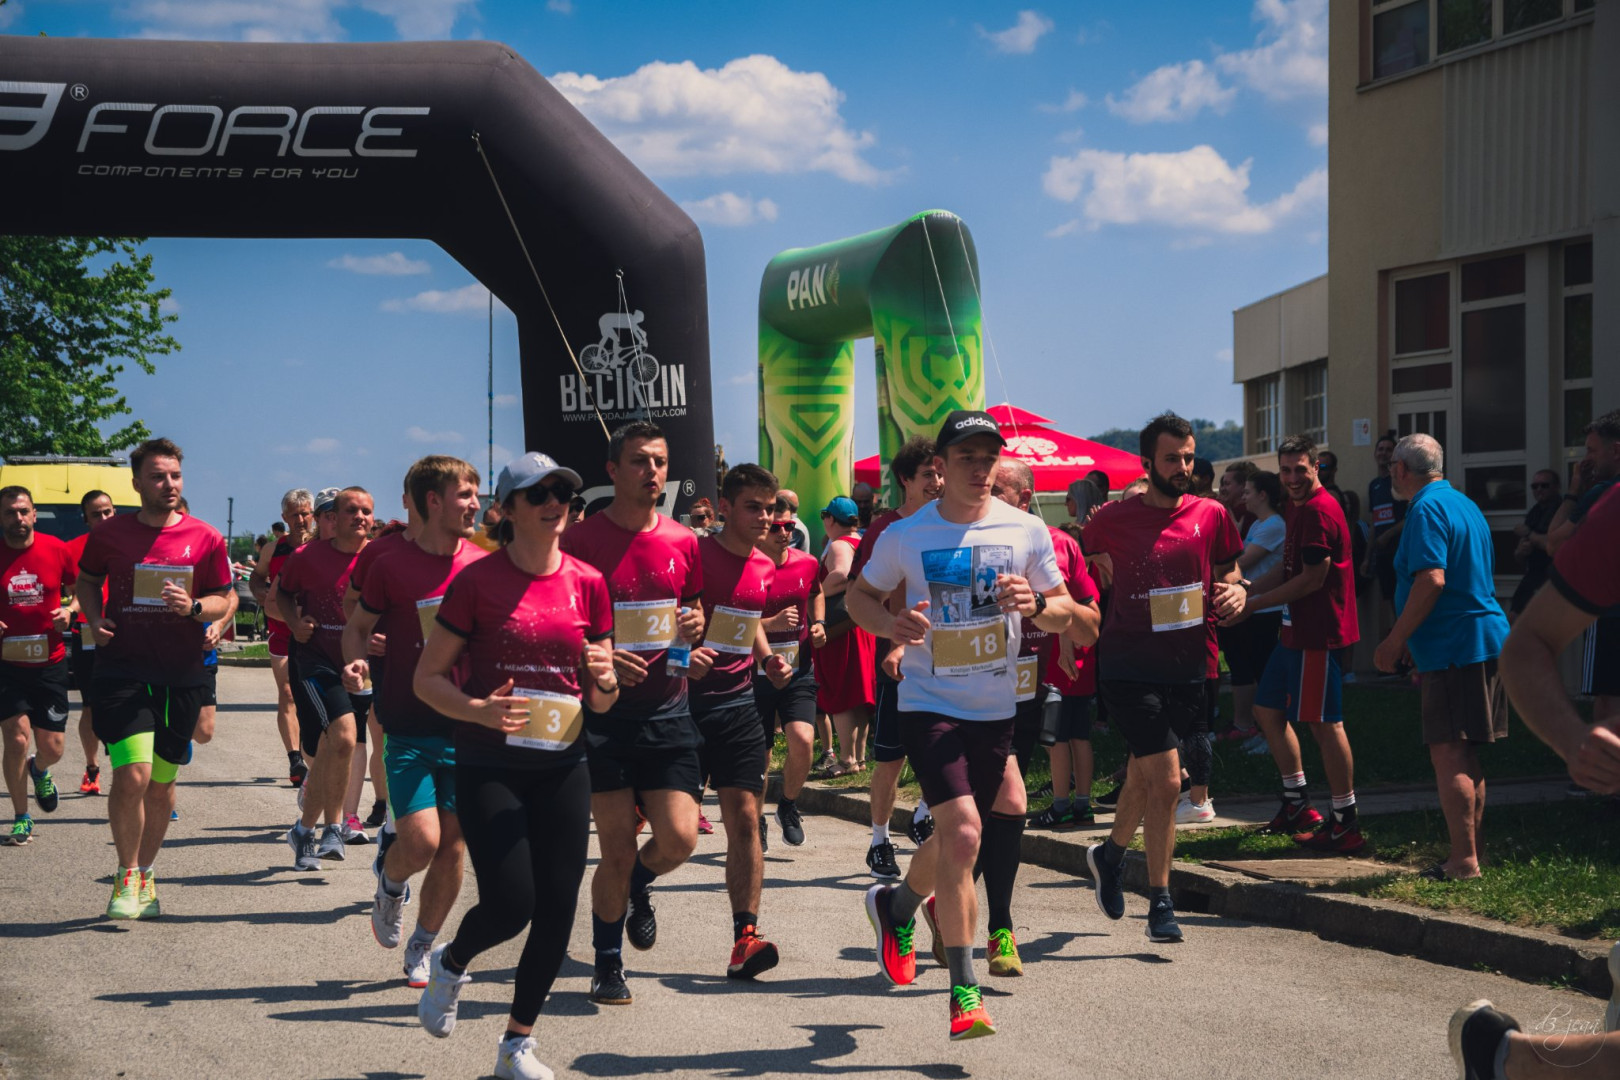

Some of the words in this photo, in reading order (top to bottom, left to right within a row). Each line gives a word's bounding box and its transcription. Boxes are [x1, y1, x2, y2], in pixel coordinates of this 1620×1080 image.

[76, 102, 430, 157] FORCE
[78, 164, 243, 179] COMPONENTS
[253, 167, 302, 179] FOR
[312, 167, 359, 179] YOU
[787, 263, 828, 311] PAN
[955, 417, 997, 430] adidas
[1178, 598, 1190, 615] 4
[647, 613, 672, 635] 24
[733, 623, 747, 640] 2
[25, 644, 43, 657] 19
[970, 633, 998, 657] 18
[546, 709, 561, 733] 3
